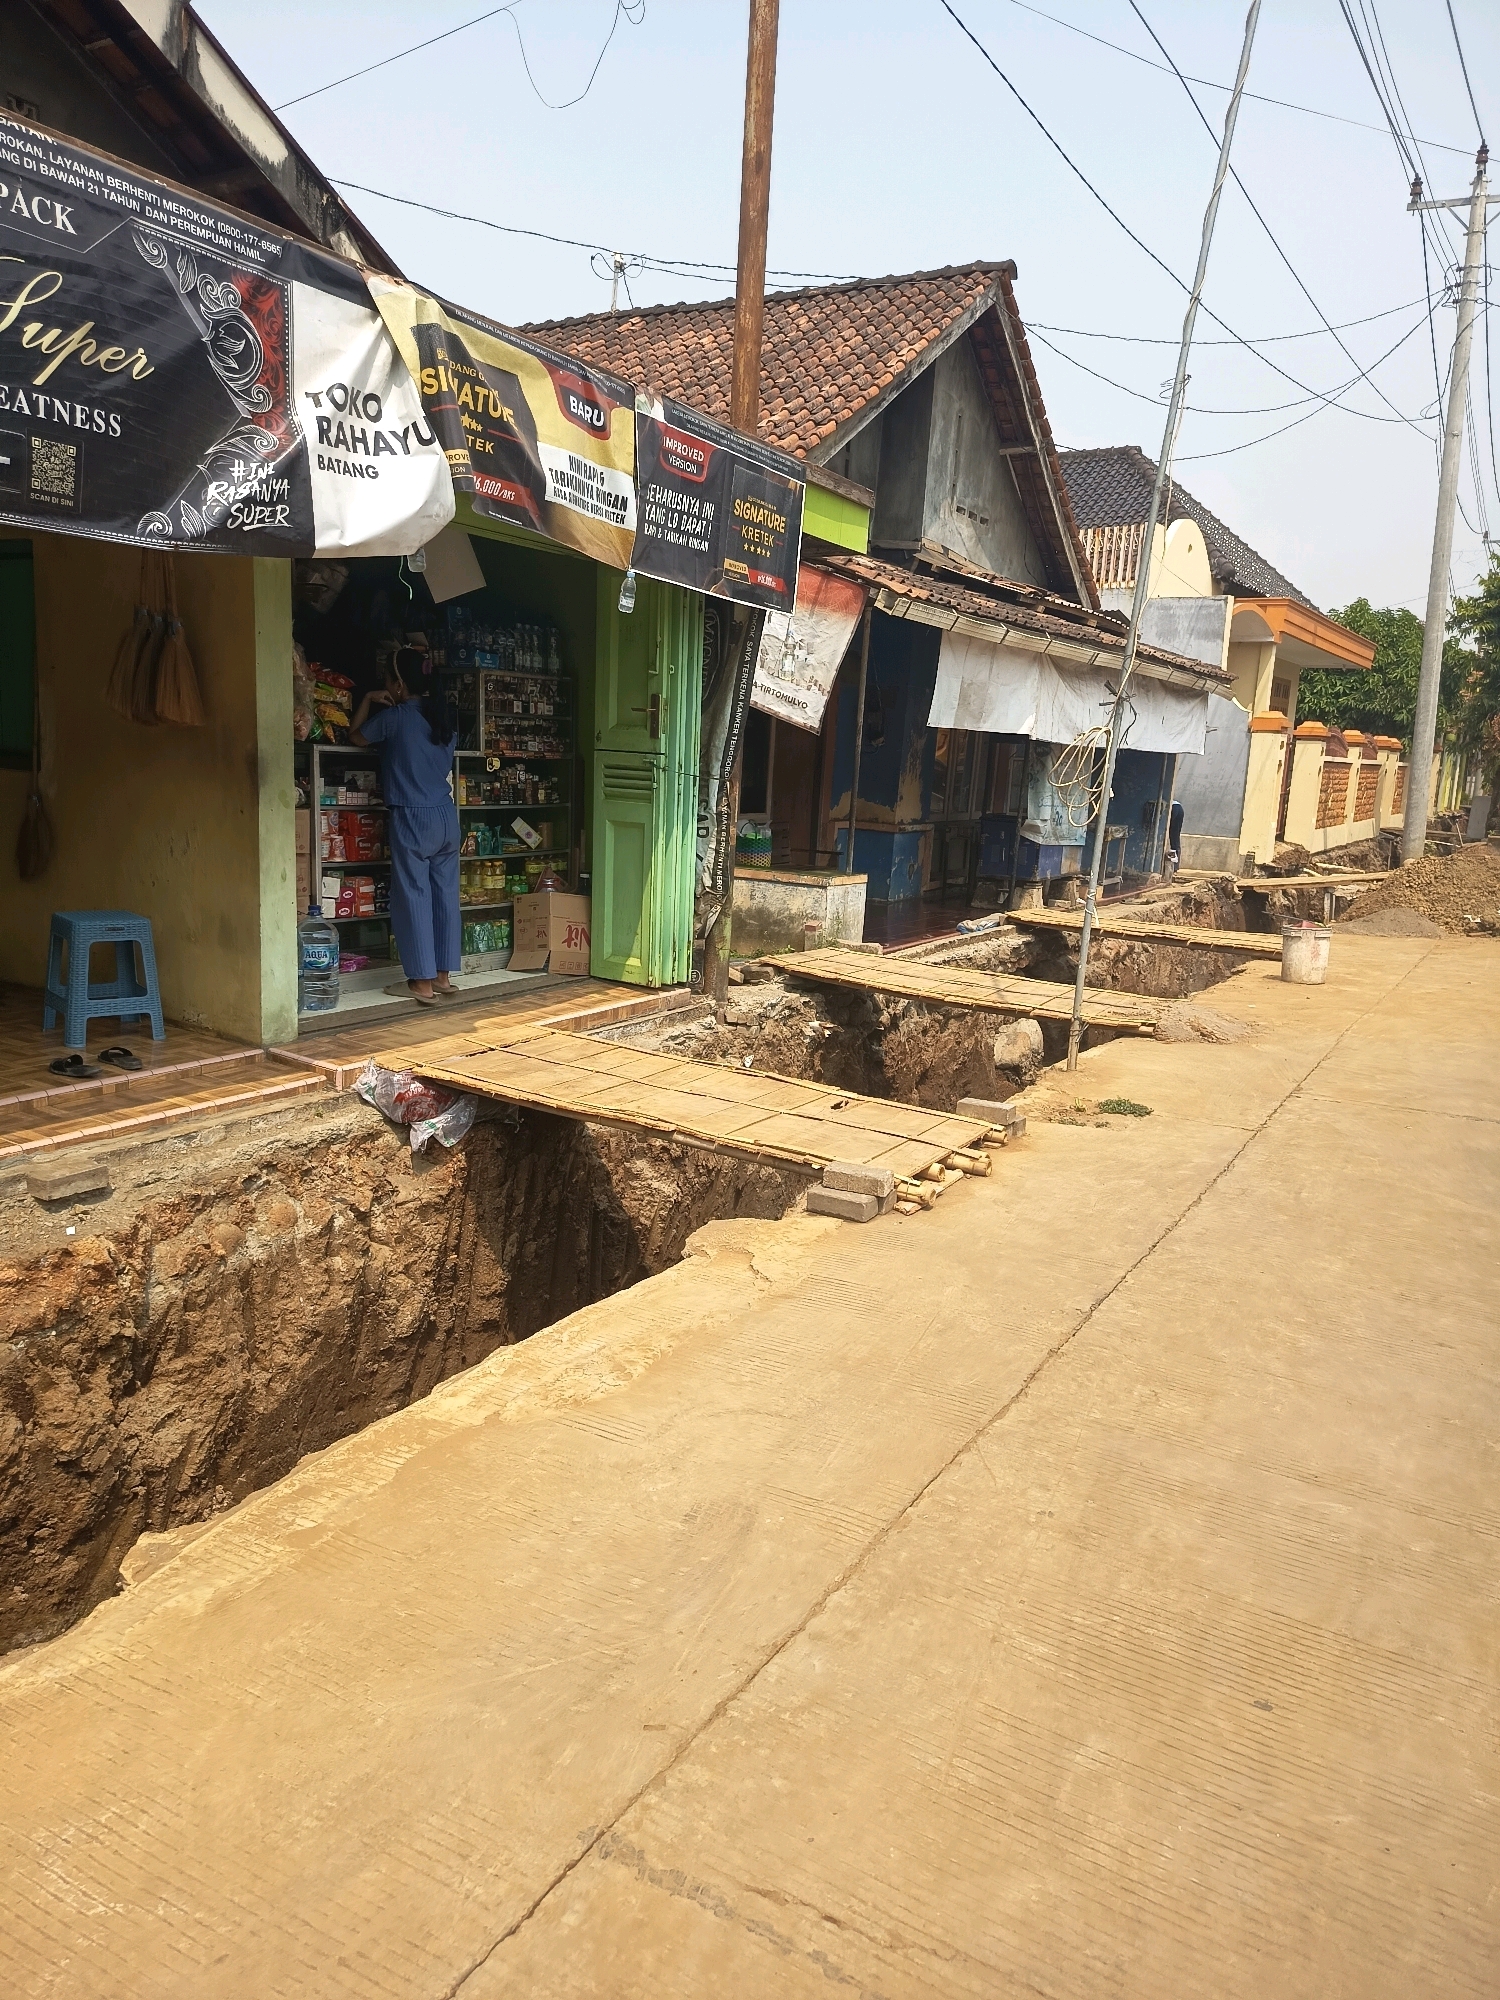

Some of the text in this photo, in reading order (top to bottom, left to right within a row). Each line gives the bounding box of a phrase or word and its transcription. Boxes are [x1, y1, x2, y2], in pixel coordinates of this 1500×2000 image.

[23, 157, 37, 171] DI
[40, 163, 85, 190] BAWAH
[87, 182, 99, 195] 21
[102, 187, 140, 213] TAHUN
[145, 206, 168, 224] DAN
[170, 215, 232, 250] PEREMPUAN
[49, 151, 105, 184] LAYANAN
[106, 175, 161, 207] BERHENTI
[163, 198, 216, 229] MEROKOK
[305, 382, 382, 423] TOKO
[569, 395, 605, 427] BARU
[316, 415, 437, 457] RAHAYU
[663, 435, 705, 462] IMPROVED
[317, 453, 380, 480] BATANG
[668, 453, 697, 474] VERSION
[30, 492, 74, 507] SCAN DI SINI
[206, 477, 291, 506] RASANYA
[226, 502, 293, 531] SUPER
[644, 502, 666, 525] YANG
[667, 510, 679, 529] LO
[680, 514, 707, 537] DAPAT
[702, 501, 715, 521] INI
[733, 498, 787, 534] SIGNATURE
[741, 524, 775, 548] KRETEK
[744, 640, 754, 661] SAYA
[738, 662, 750, 700] TERKENA
[732, 701, 745, 734] KANKER
[561, 924, 591, 951] Vit
[304, 950, 329, 960] AQUA
